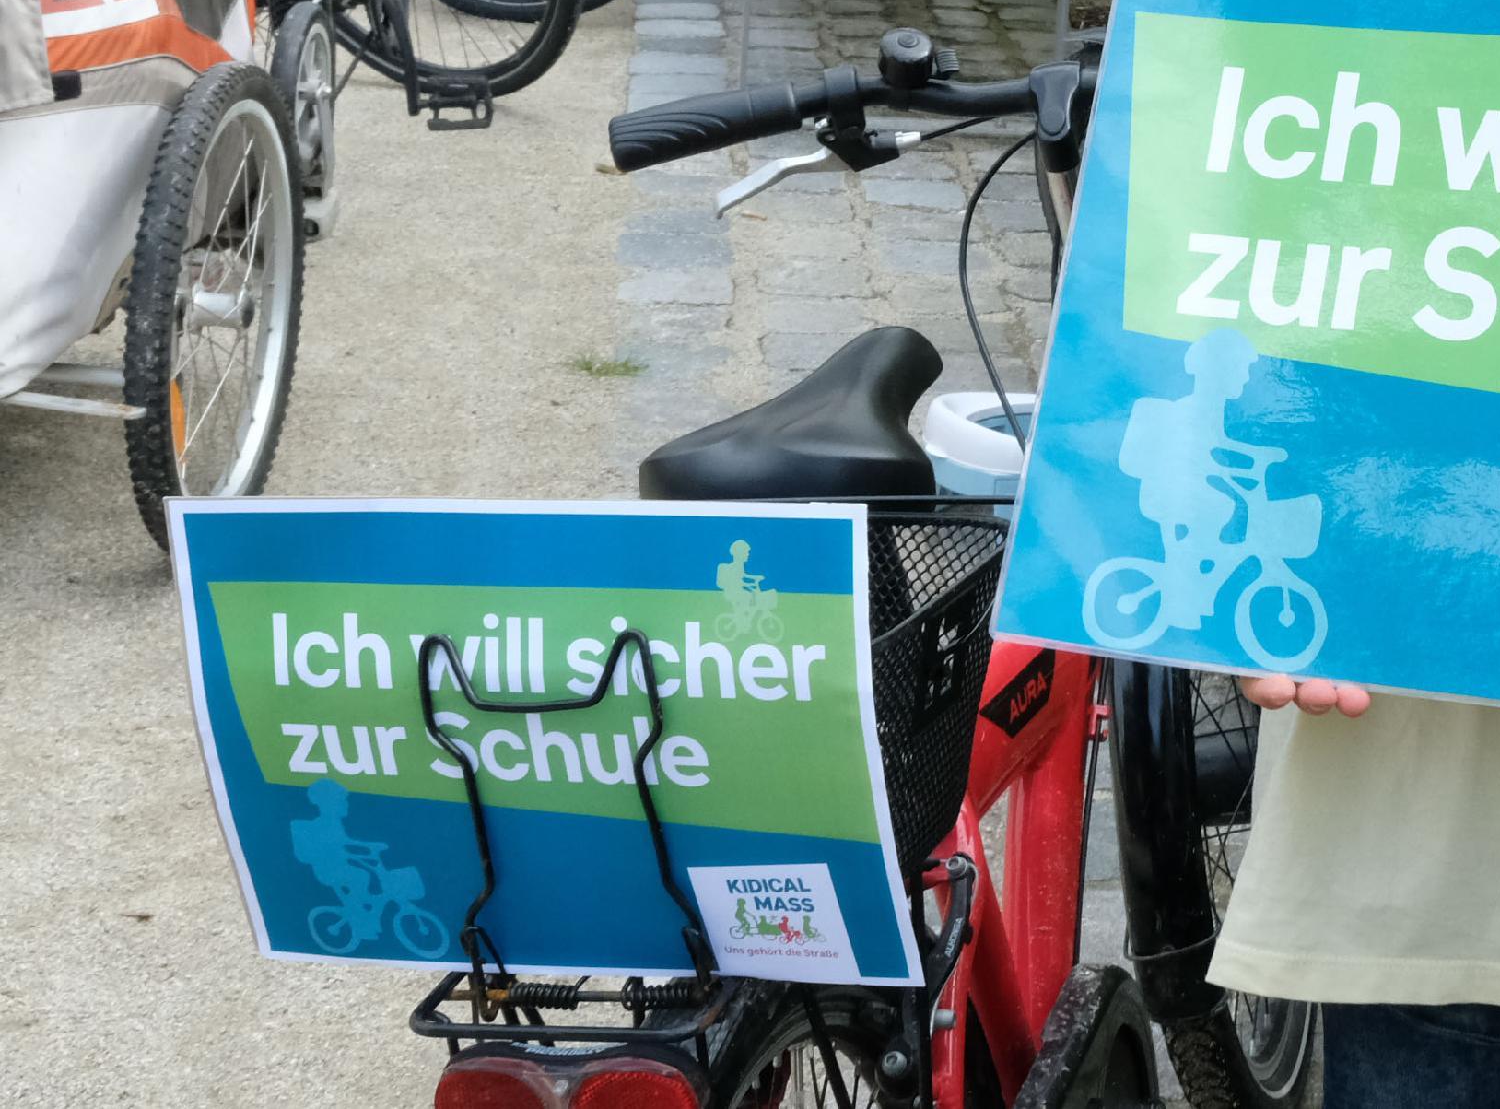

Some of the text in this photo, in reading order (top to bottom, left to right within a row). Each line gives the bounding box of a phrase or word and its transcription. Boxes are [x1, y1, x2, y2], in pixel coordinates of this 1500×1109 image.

[1206, 66, 1401, 186] Ich
[1176, 232, 1392, 331] zur
[272, 612, 826, 702] Ich will sicher
[1009, 671, 1048, 724] AURA
[281, 711, 711, 787] zur Schule
[726, 878, 812, 894] KIDICAL
[754, 896, 815, 912] MASS
[724, 945, 839, 959] Uns gehört die Straße
